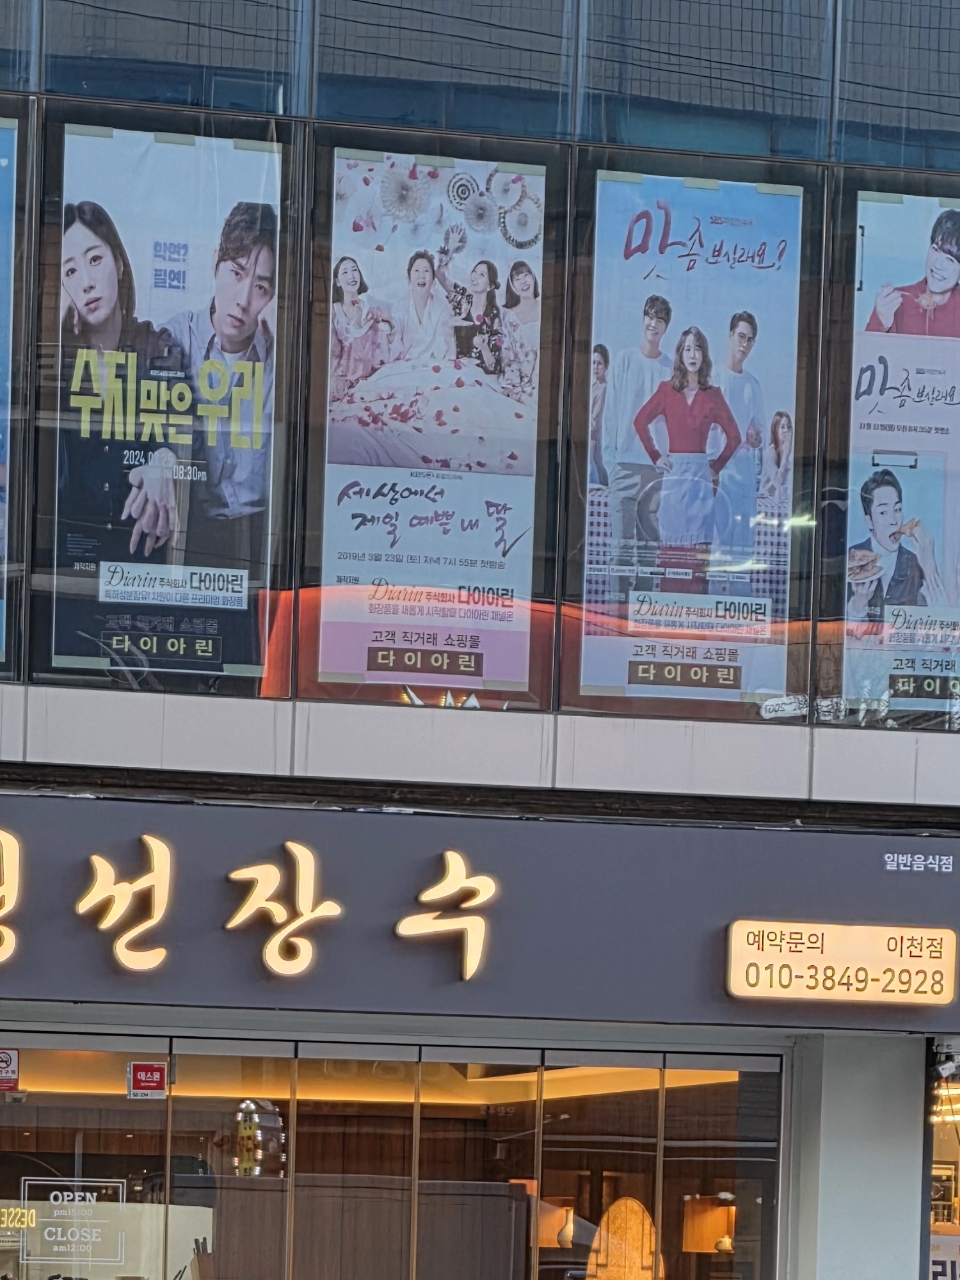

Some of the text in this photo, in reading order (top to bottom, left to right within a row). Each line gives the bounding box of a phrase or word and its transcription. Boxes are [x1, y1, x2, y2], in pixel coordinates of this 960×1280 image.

[623, 198, 788, 281] 맛 좀 보실래요?
[153, 241, 188, 263] 악연?
[153, 268, 186, 290] 필연!
[854, 355, 900, 415] 맛
[892, 368, 912, 409] 좀
[70, 348, 264, 449] 수지맞은 우리
[337, 480, 445, 506] 세상에서
[351, 500, 532, 559] 제일 예쁜 내 딸
[337, 551, 366, 562] 2019년
[368, 552, 382, 562] 3월
[384, 553, 404, 563] 23일
[442, 556, 457, 566] 7시
[458, 558, 478, 568] 55분
[104, 564, 244, 593] Diarin 주식회사 다이아린
[368, 577, 424, 603] Diarin
[458, 585, 514, 608] 다이아린
[633, 593, 684, 618] Diarin
[715, 600, 767, 622] 다이아린
[111, 634, 213, 656] 다이아린
[371, 630, 481, 649] 고객 직거래 쇼핑몰
[377, 651, 476, 671] 다이아린
[632, 644, 740, 663] 고객 직거래 쇼핑몰
[638, 664, 735, 684] 다이아린
[893, 658, 956, 673] 고객 직거래
[884, 853, 953, 872] 일반음식점
[746, 929, 943, 959] 예약문의 이천점
[745, 962, 944, 995] 010-3849-2928
[49, 1191, 98, 1206] OPEN
[43, 1227, 102, 1242] CLOSE
